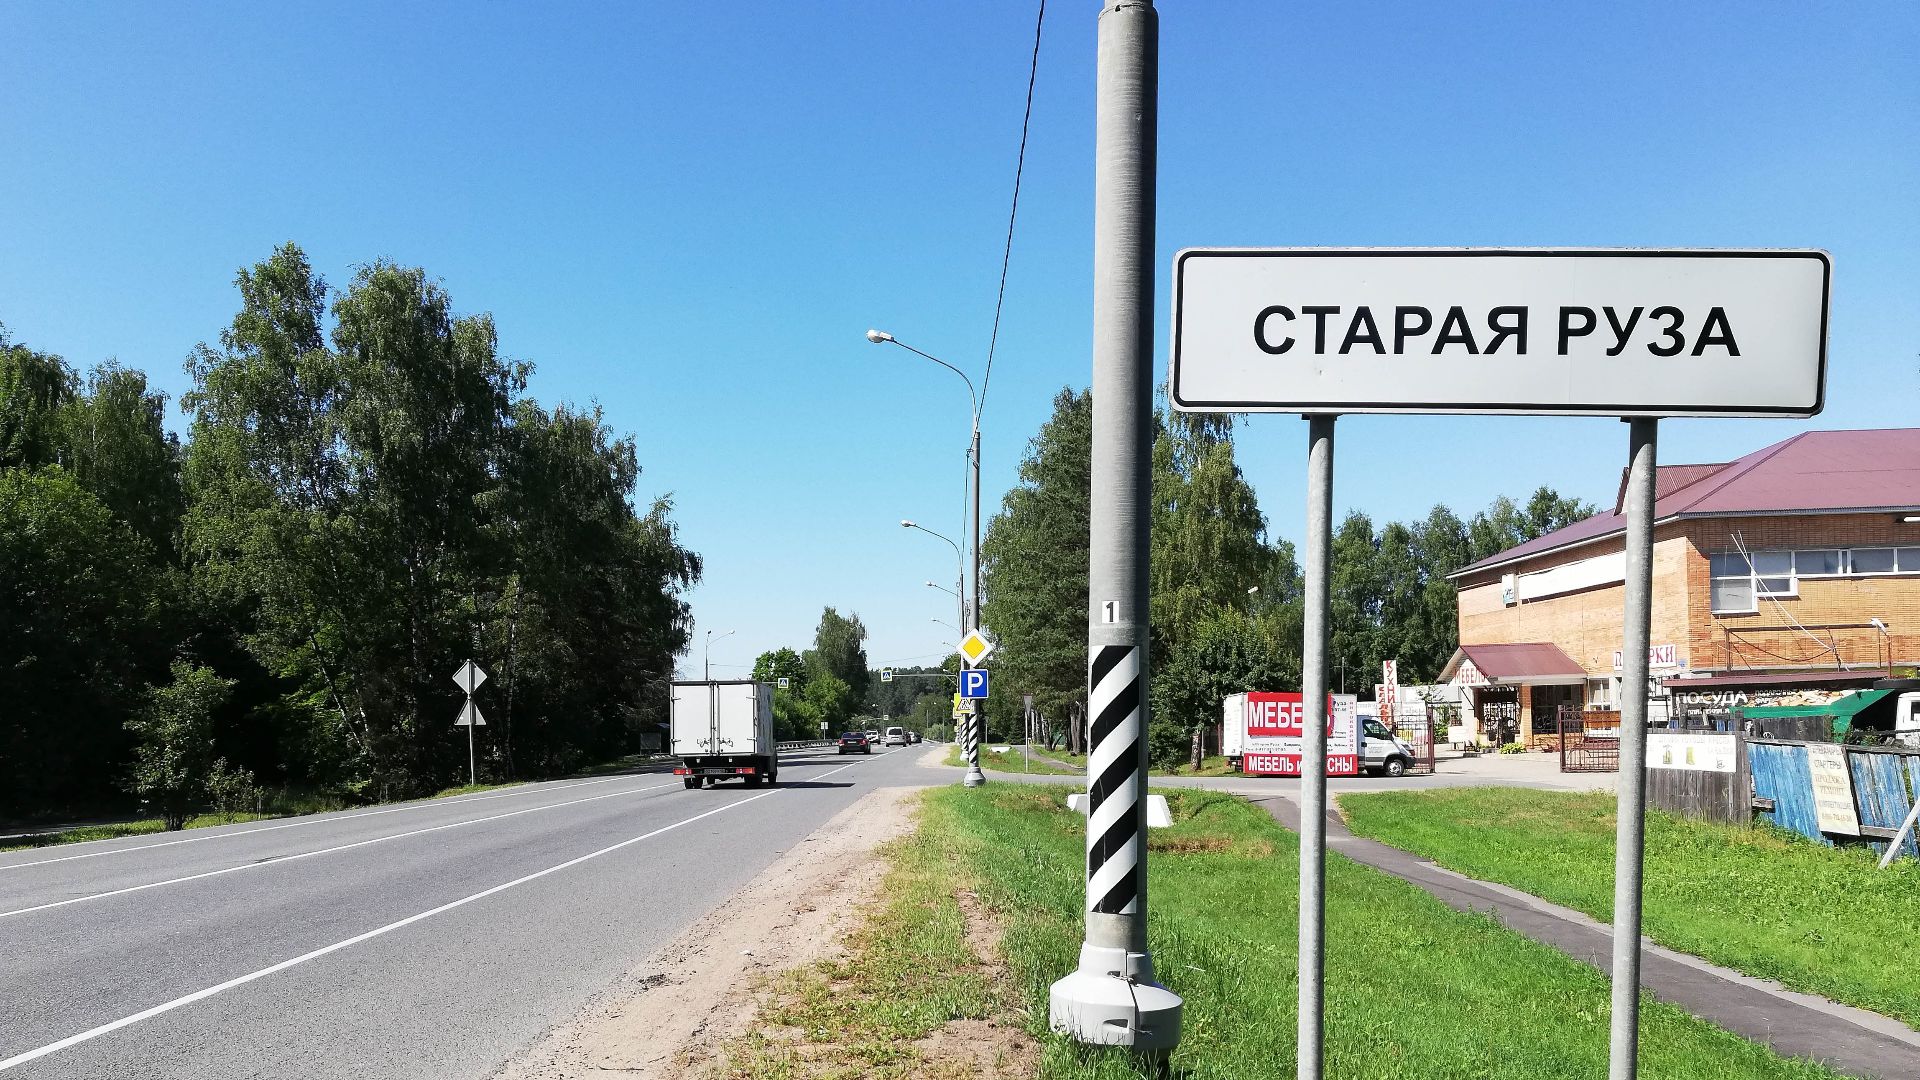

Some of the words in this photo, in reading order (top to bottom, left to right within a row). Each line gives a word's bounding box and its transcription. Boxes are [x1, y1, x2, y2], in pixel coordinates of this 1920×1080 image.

[1253, 304, 1528, 356] СТАРАЯ
[1556, 305, 1742, 356] РУЗА
[1105, 601, 1114, 623] 1
[1615, 646, 1674, 667] ПРКИ
[967, 672, 984, 696] P
[1385, 660, 1396, 704] КУХНИ
[1675, 690, 1748, 707] ПОСУДА
[1248, 701, 1331, 729] МЕБЕ
[1248, 756, 1293, 772] МЕБЕЛЬ
